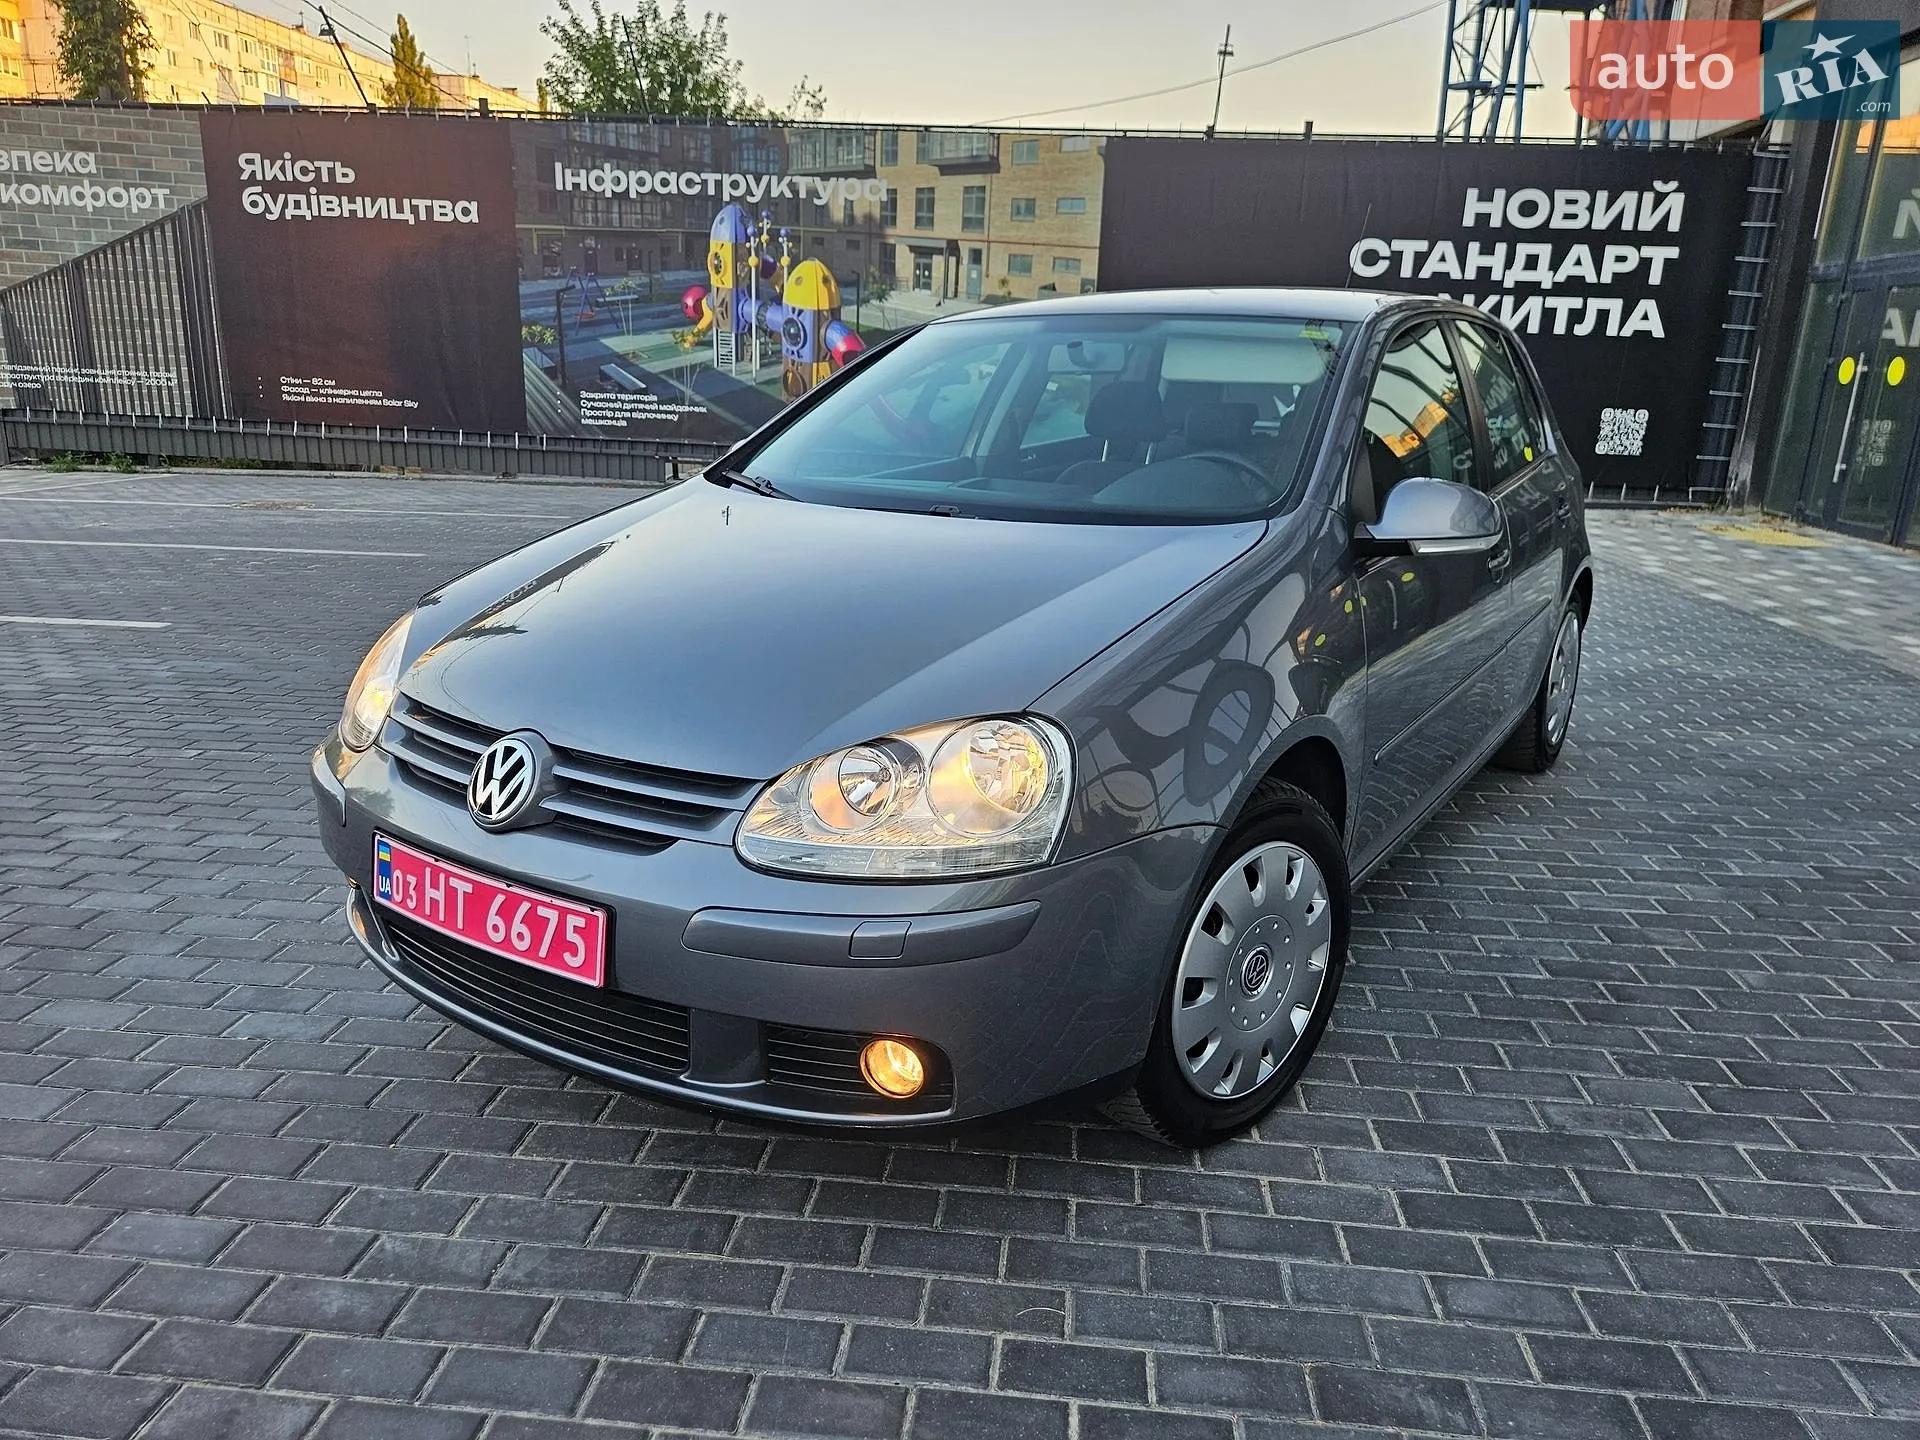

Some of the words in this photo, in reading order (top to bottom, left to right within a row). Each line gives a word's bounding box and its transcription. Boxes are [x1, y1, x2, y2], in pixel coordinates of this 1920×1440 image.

[238, 152, 356, 184] Якість
[553, 161, 889, 206] Інфраструктура
[0, 179, 170, 214] комфорт
[241, 187, 480, 224] будівництва
[1462, 180, 1686, 233] НОВИЙ
[1349, 238, 1680, 290] СТАНДАРТ
[403, 399, 419, 409] Sky
[580, 390, 616, 400] Закрита
[581, 408, 614, 418] Простір
[379, 874, 392, 895] UA
[486, 893, 587, 969] 6675
